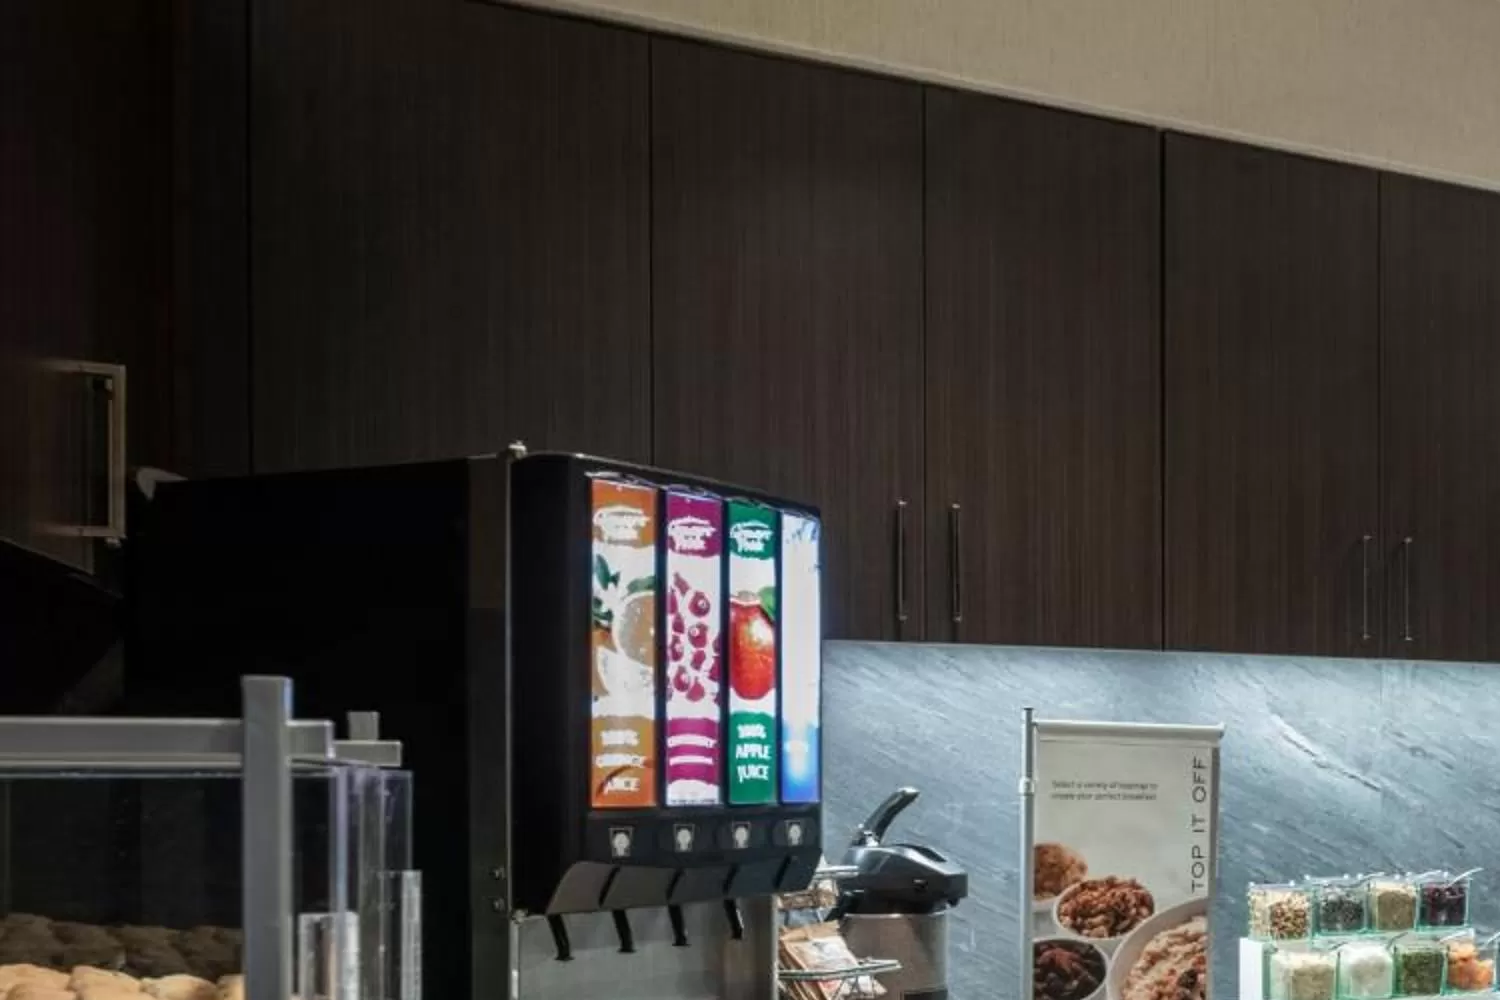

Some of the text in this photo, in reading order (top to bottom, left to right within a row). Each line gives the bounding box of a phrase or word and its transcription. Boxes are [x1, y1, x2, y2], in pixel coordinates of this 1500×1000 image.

[735, 743, 772, 760] APPLE
[737, 764, 769, 784] JUICE
[1190, 756, 1207, 894] TOP IT OFF
